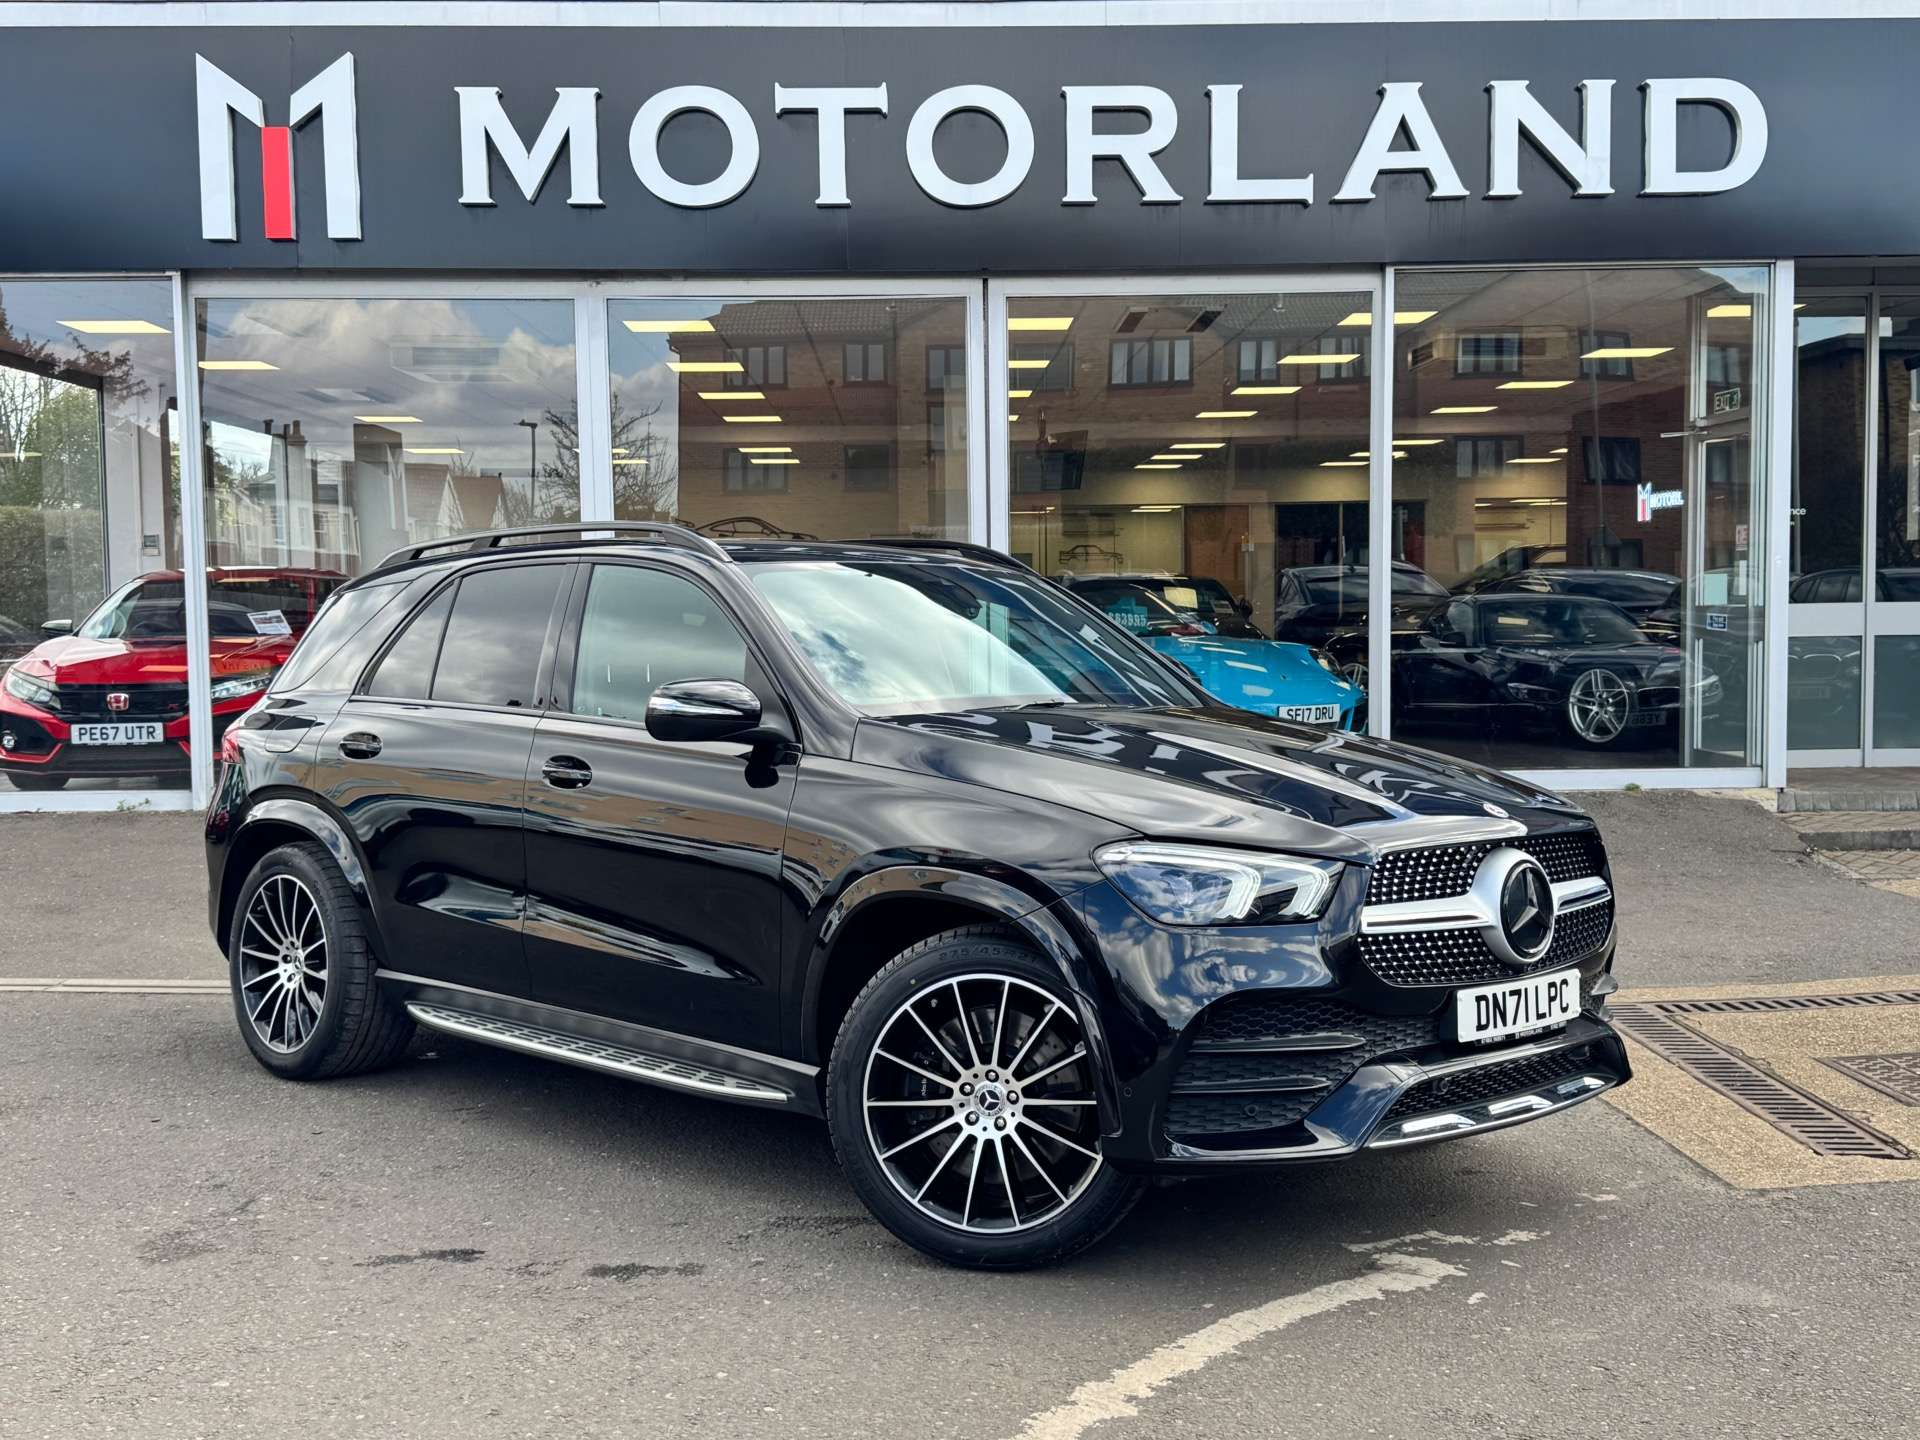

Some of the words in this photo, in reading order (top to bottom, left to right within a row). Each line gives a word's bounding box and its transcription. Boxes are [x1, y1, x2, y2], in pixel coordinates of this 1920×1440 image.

[454, 76, 1769, 209] MOTORLAND
[1314, 706, 1334, 720] DRU
[78, 726, 119, 741] PE67
[125, 725, 156, 740] UTR
[1475, 986, 1530, 1032] DN71
[1534, 978, 1569, 1021] LPC
